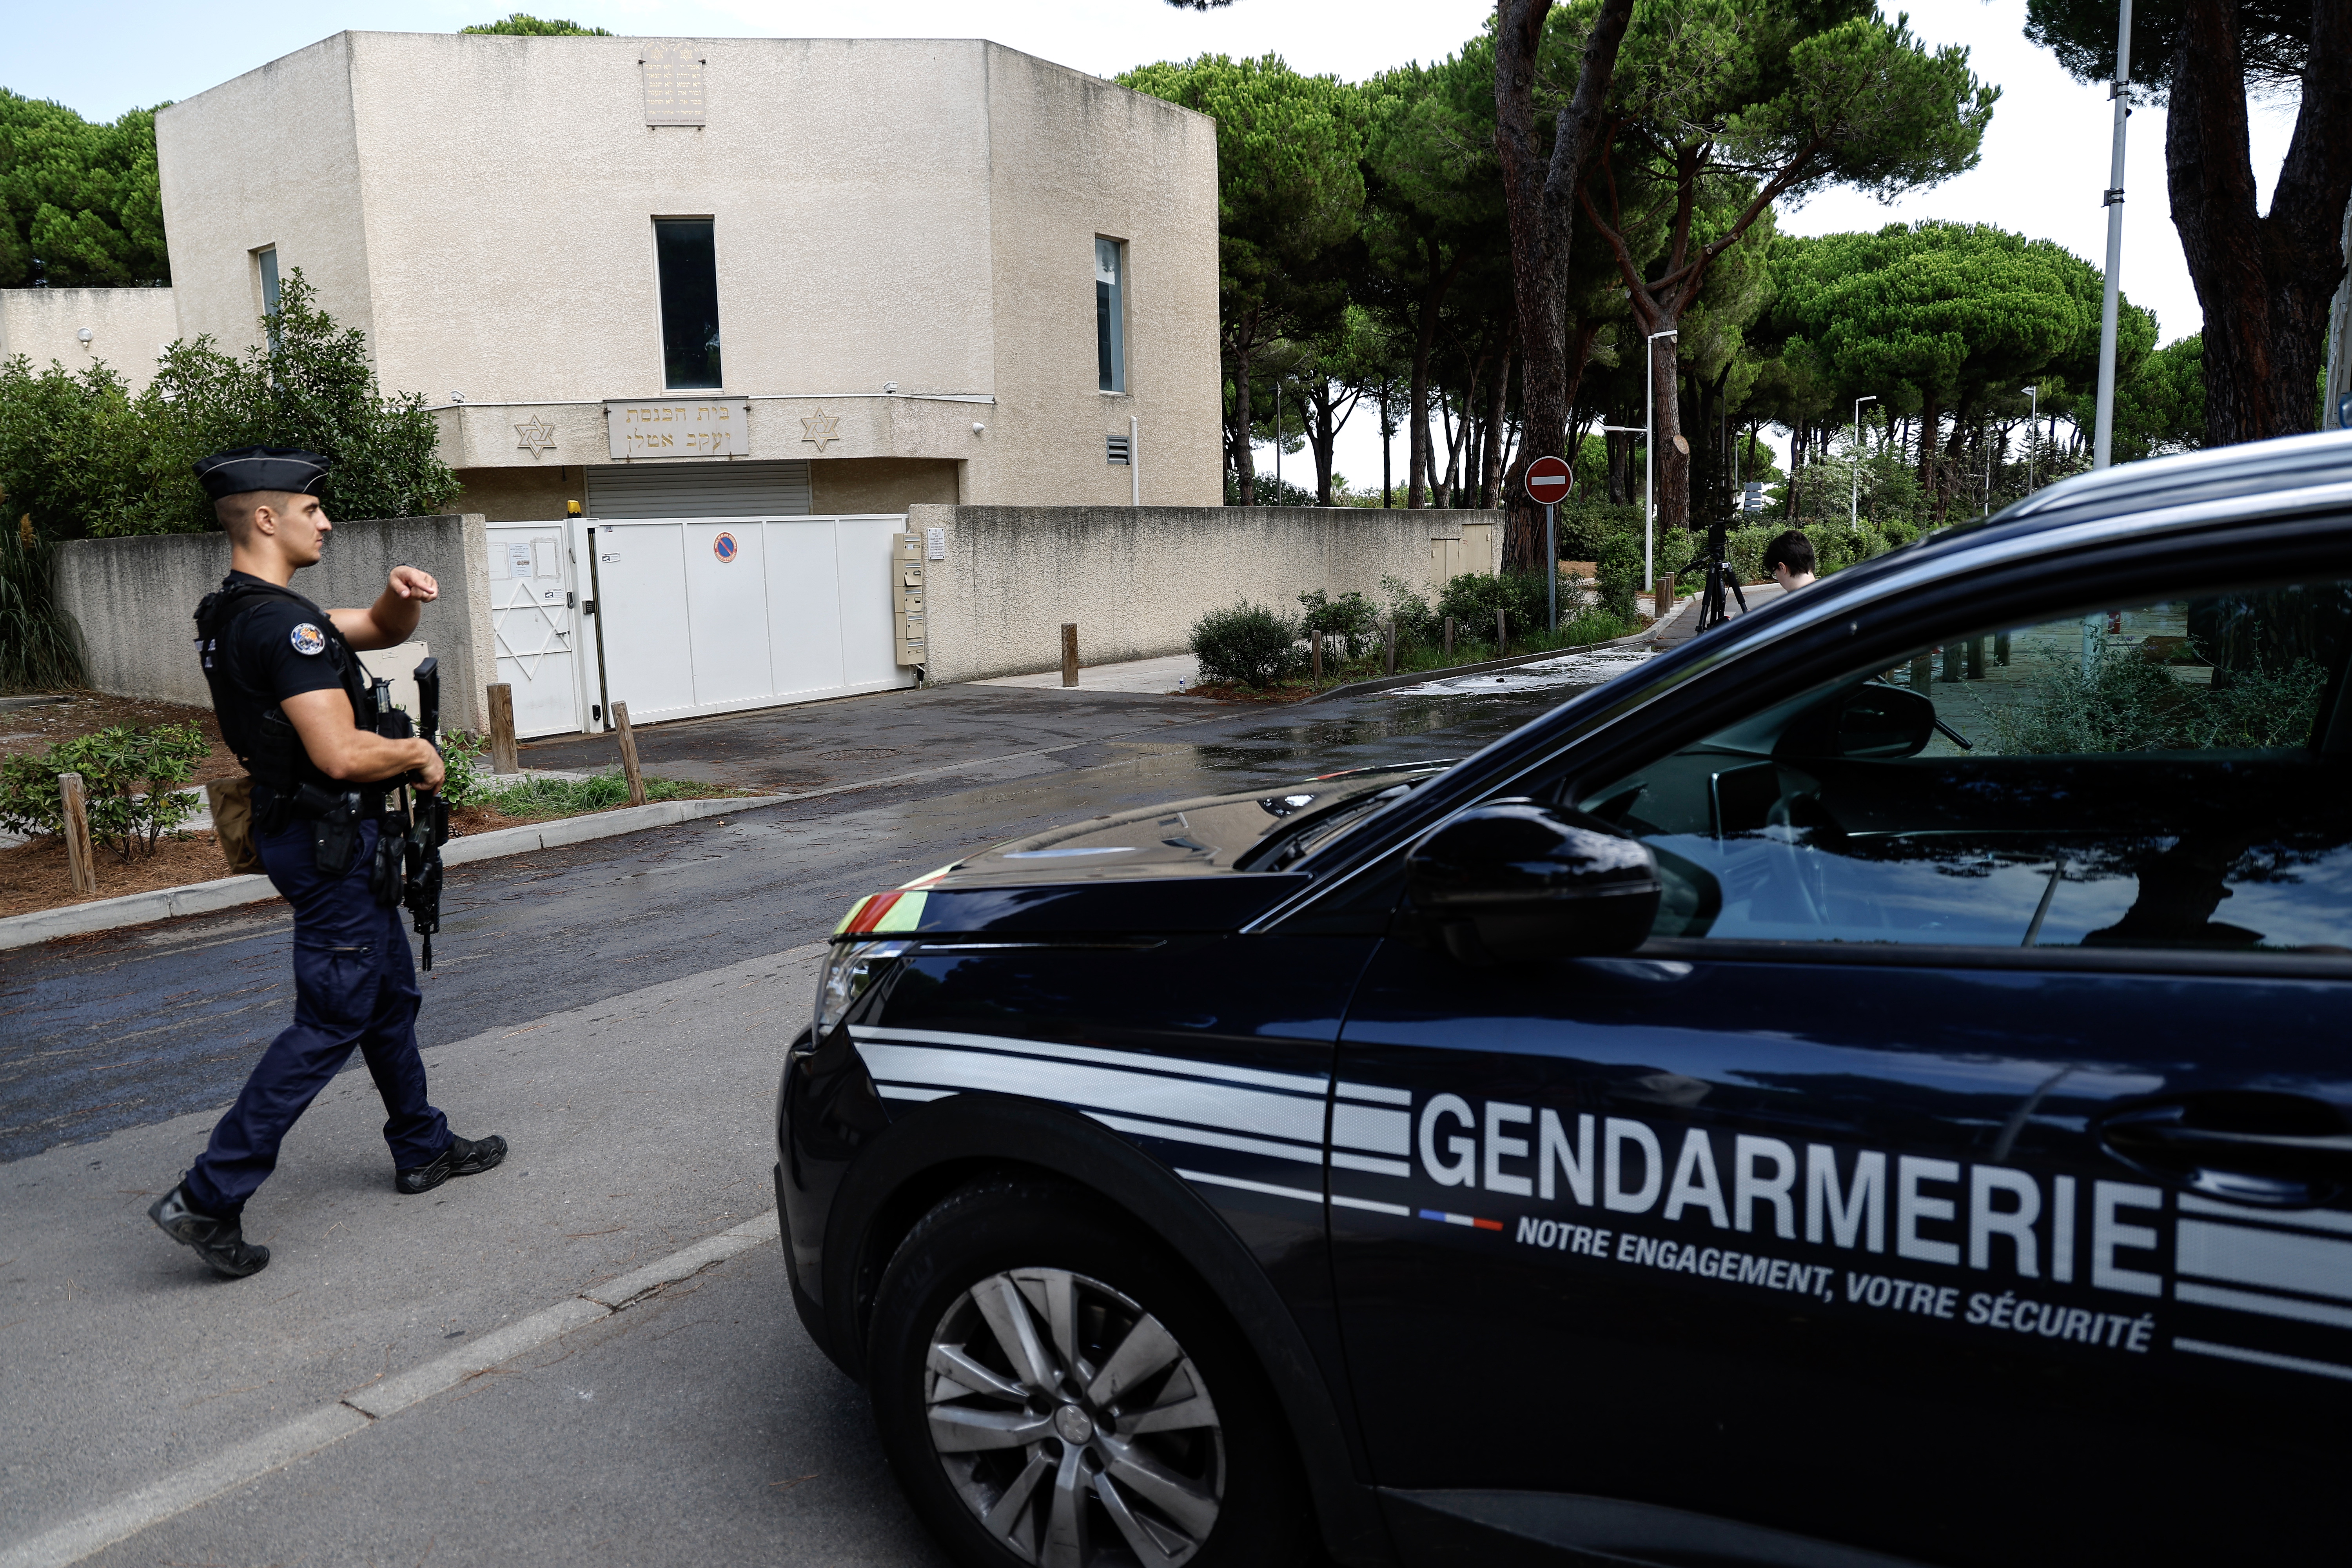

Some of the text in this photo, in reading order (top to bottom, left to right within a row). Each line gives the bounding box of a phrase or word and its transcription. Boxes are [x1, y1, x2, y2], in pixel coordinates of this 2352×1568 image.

[627, 427, 730, 453] יעקב אטלן
[1419, 1093, 2162, 1298] GENDARMERIE
[1516, 1216, 2155, 1353] NOTRE ENGAGEMENT, VOTRE SÉCURITÉ
